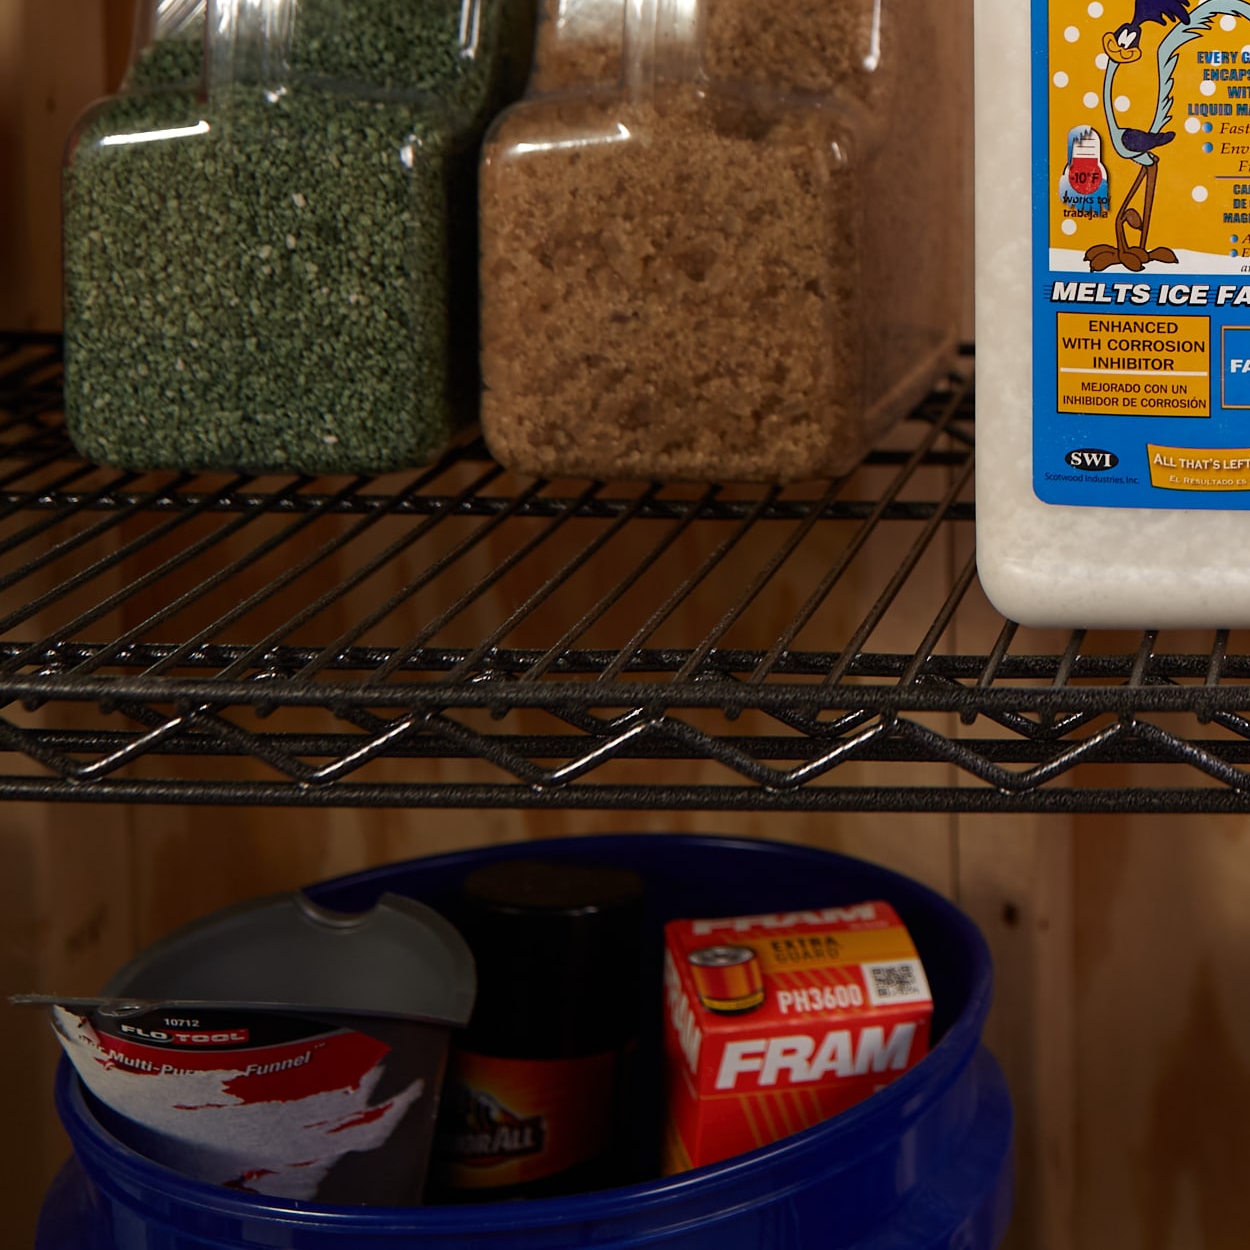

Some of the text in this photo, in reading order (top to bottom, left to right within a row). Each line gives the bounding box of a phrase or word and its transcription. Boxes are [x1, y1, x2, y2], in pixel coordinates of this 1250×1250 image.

[1197, 51, 1238, 64] EVERY
[1188, 104, 1232, 116] LIQUID
[1219, 122, 1250, 135] Fast
[1063, 195, 1094, 203] works
[1233, 199, 1247, 209] DE
[1063, 209, 1099, 221] trabaja
[1051, 282, 1151, 304] MELTS
[1156, 284, 1210, 305] ICE
[1089, 320, 1178, 334] ENHANCED
[1062, 337, 1205, 352] WITH CORROSION
[1093, 356, 1174, 370] INHIBITOR
[1081, 382, 1187, 394] MEJORADO CON UN
[1063, 395, 1206, 409] INHIBIDOR DE CORROSIÓN
[1070, 452, 1112, 467] SWI
[1153, 453, 1177, 468] ALL
[1223, 459, 1250, 470] LEFT
[1044, 472, 1084, 482] Scotwood
[770, 936, 839, 953] EXTRA
[775, 948, 840, 963] GUARD
[776, 984, 863, 1014] PH3600
[164, 1018, 201, 1028] 10712
[120, 1024, 246, 1043] FLO TOOL
[714, 1021, 917, 1090] FRAM
